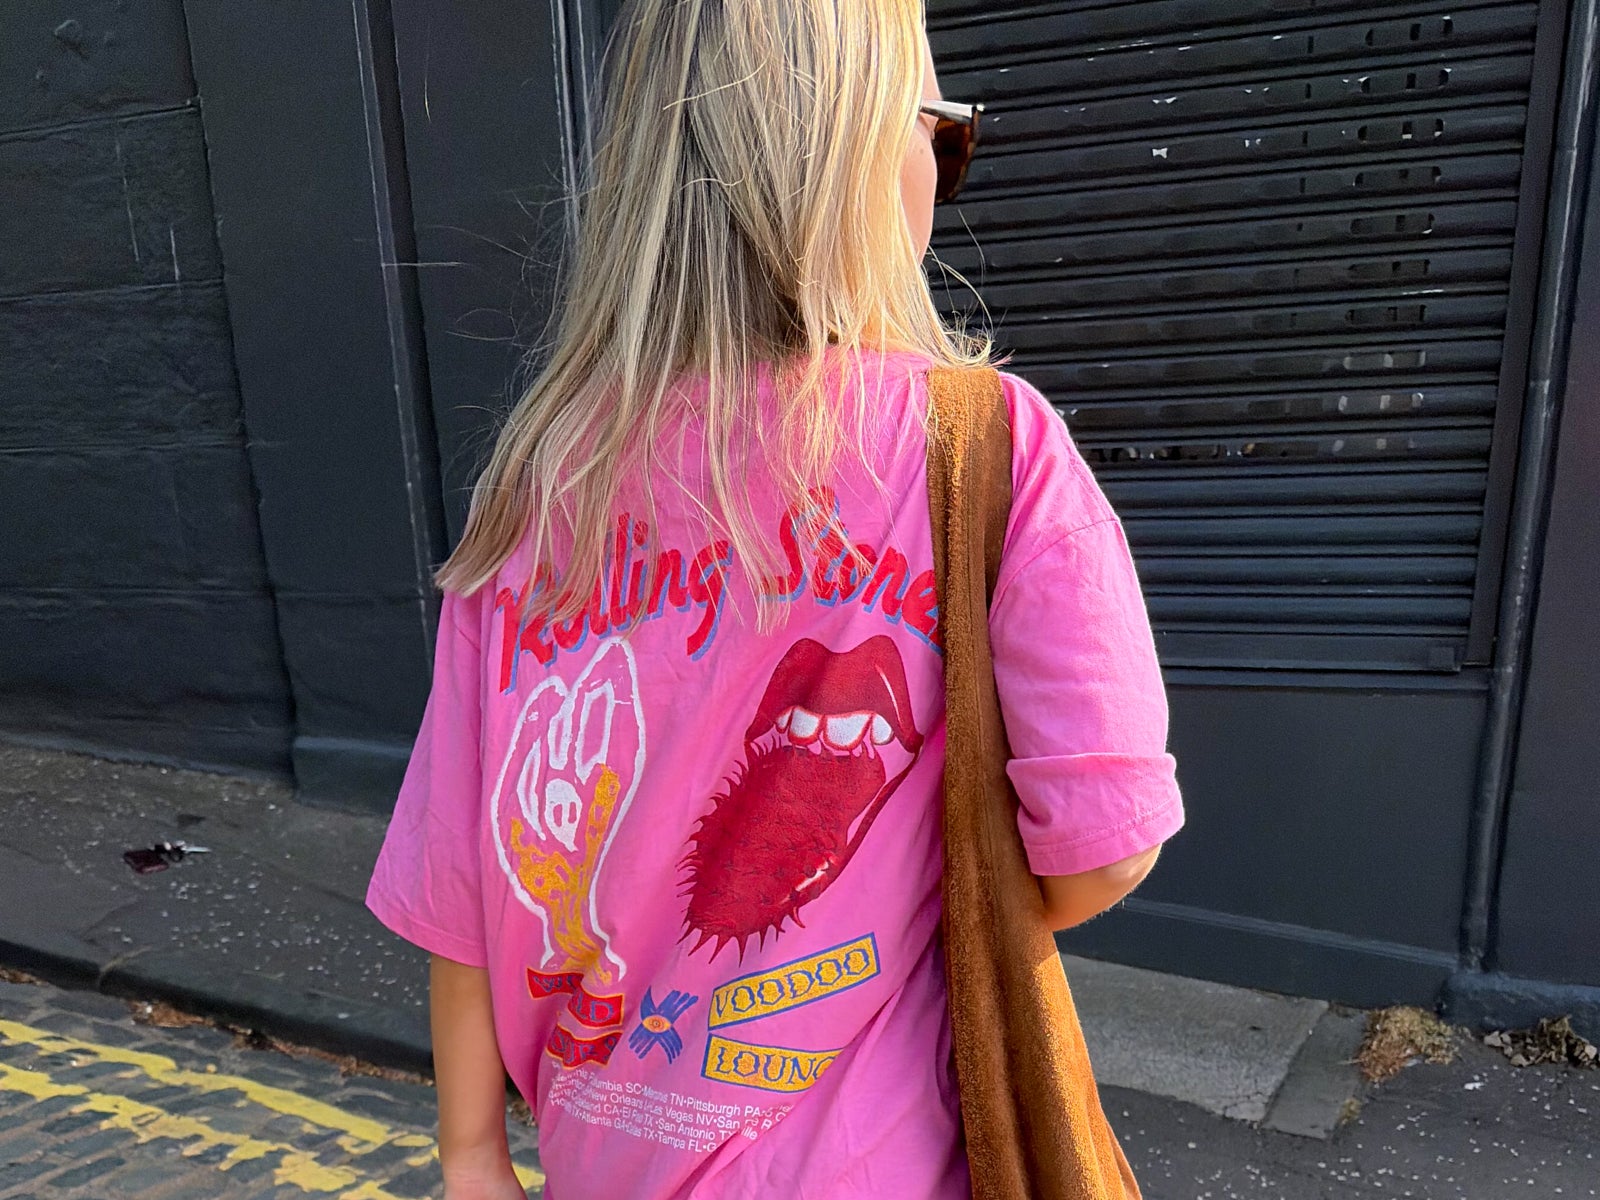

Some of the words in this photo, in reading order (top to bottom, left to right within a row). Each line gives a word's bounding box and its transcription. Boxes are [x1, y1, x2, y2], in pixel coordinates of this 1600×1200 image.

[495, 511, 734, 695] Rolling
[758, 485, 943, 657] Stone
[715, 948, 870, 1018] VOODOO
[713, 1046, 837, 1085] LOUN
[643, 1113, 653, 1127] TX
[677, 1122, 716, 1141] Antonio
[664, 1106, 694, 1123] Vegas
